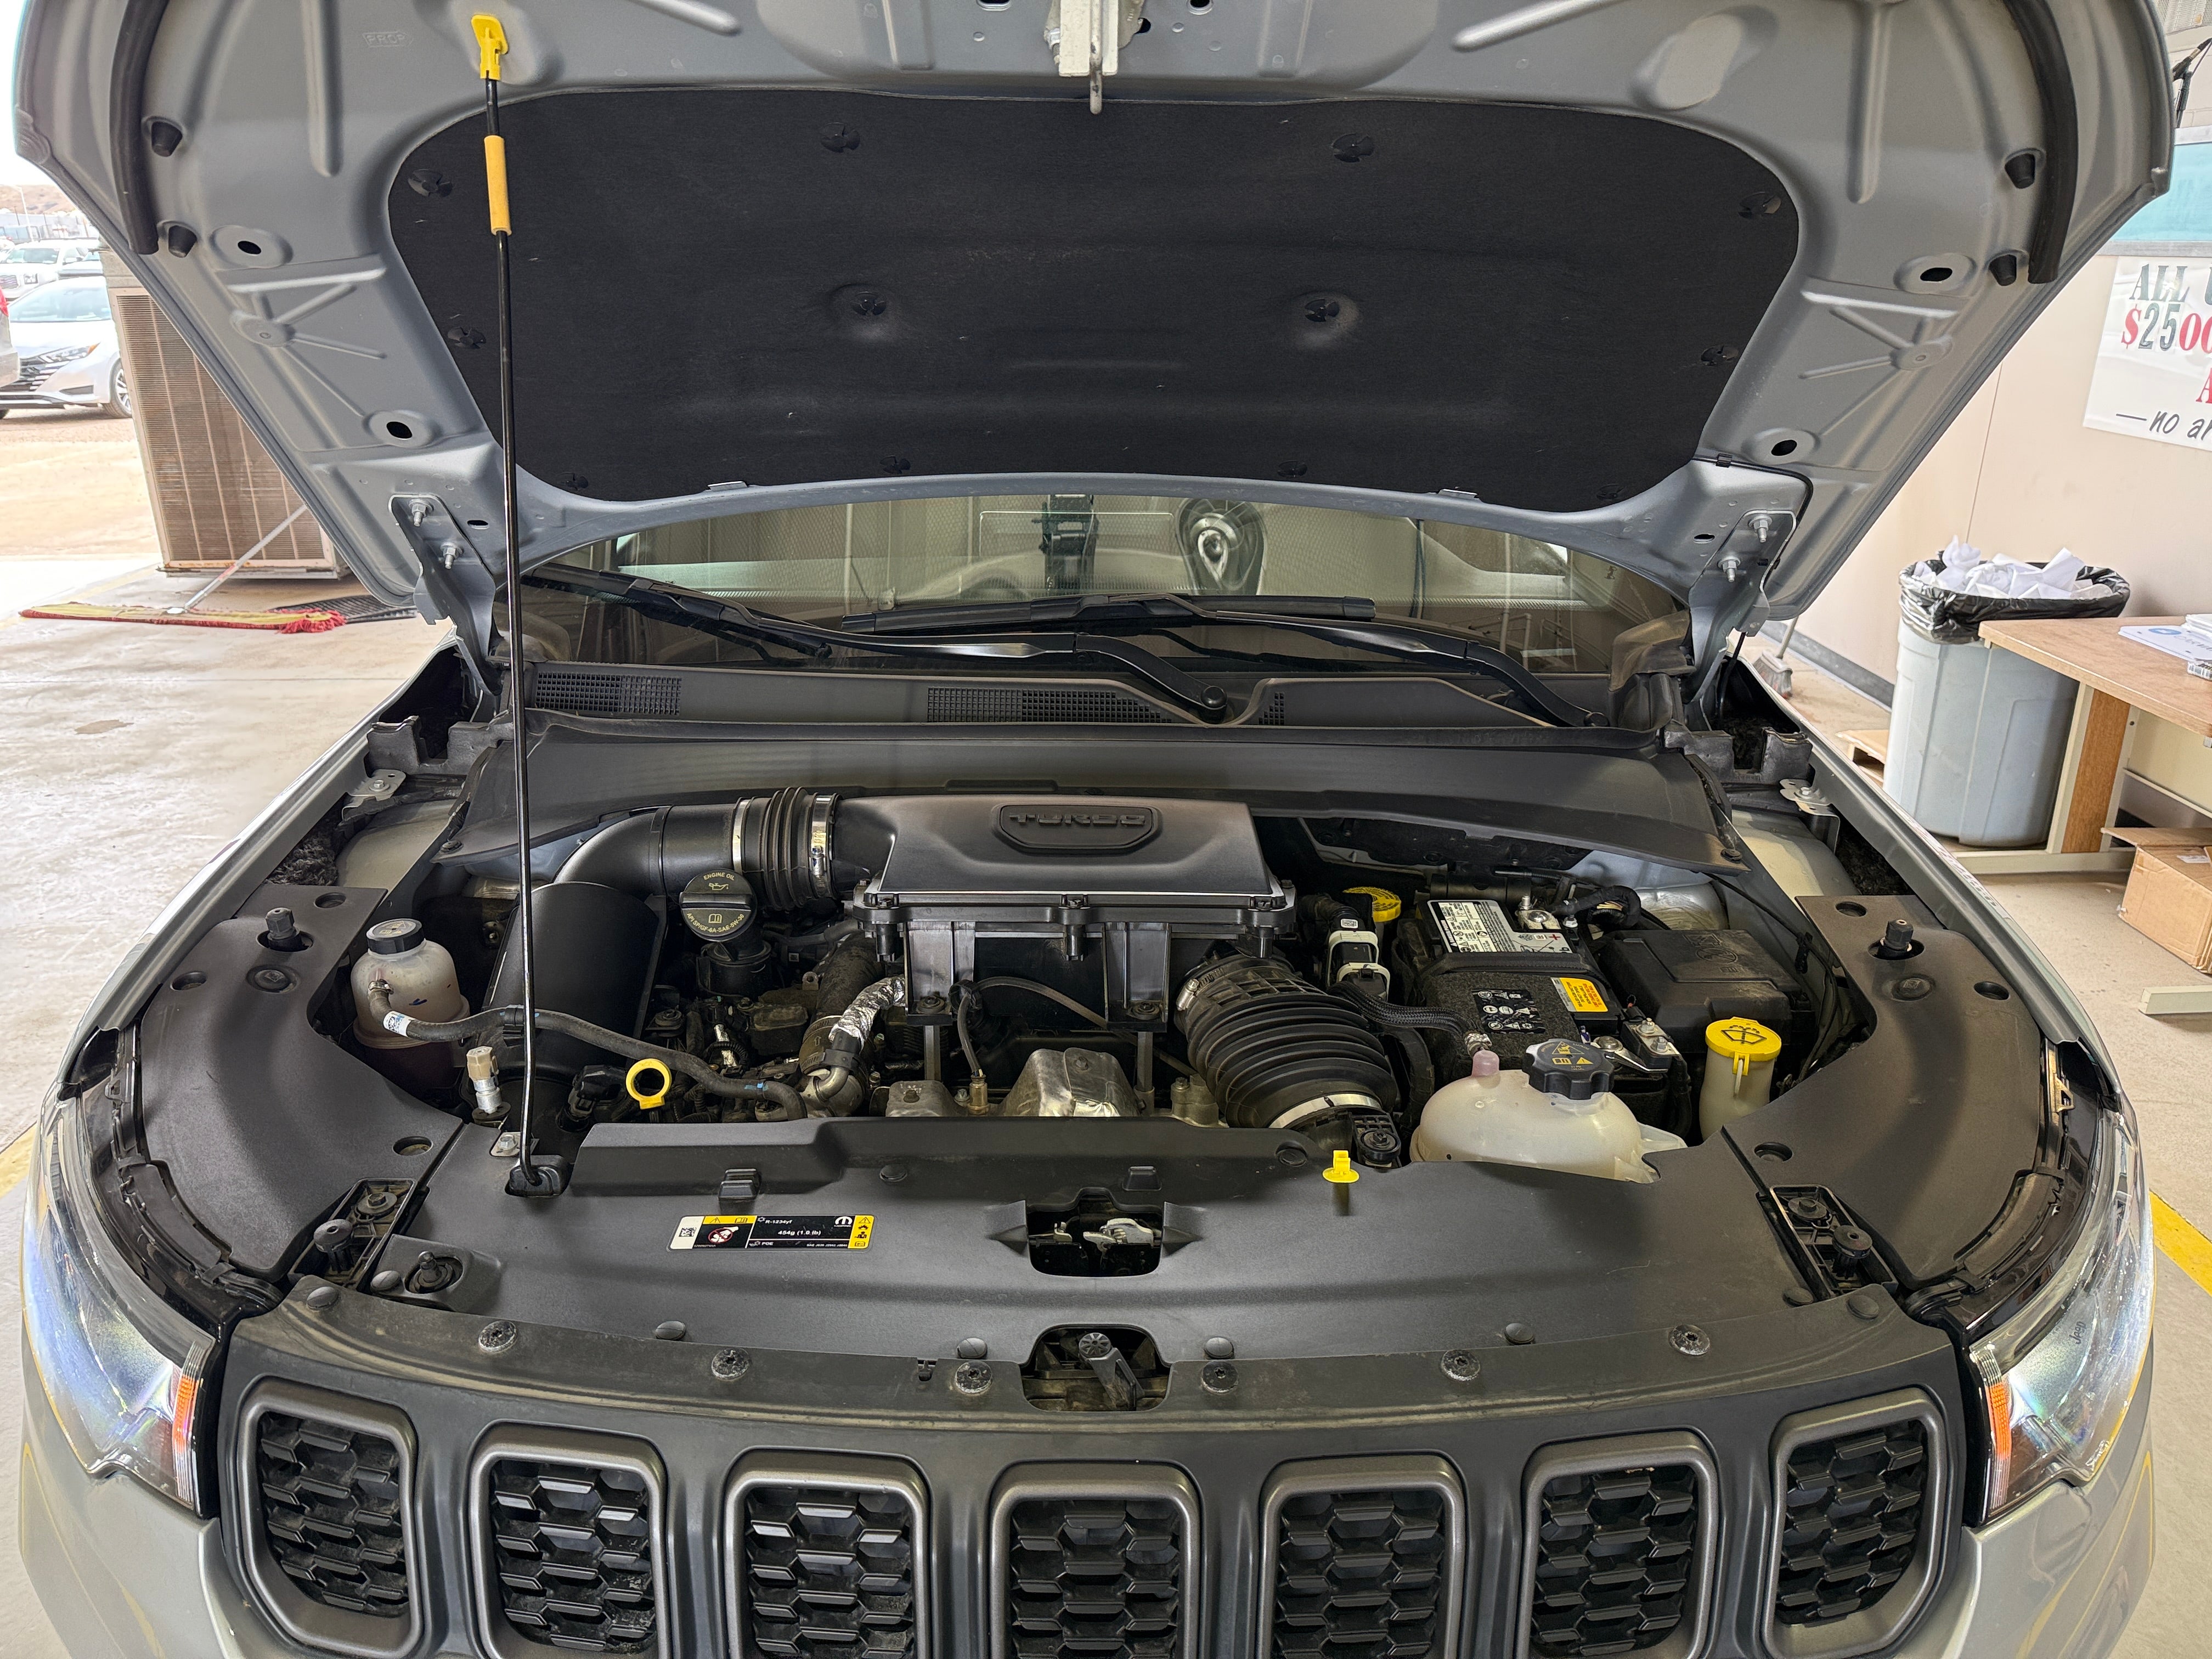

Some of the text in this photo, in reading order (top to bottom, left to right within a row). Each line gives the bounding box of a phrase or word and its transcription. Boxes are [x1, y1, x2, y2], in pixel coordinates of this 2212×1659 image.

[2129, 263, 2190, 302] ALL
[1009, 812, 1145, 826] TURBO
[703, 872, 725, 881] ENGINE
[686, 913, 695, 922] API
[2069, 1321, 2087, 1345] Jeep
